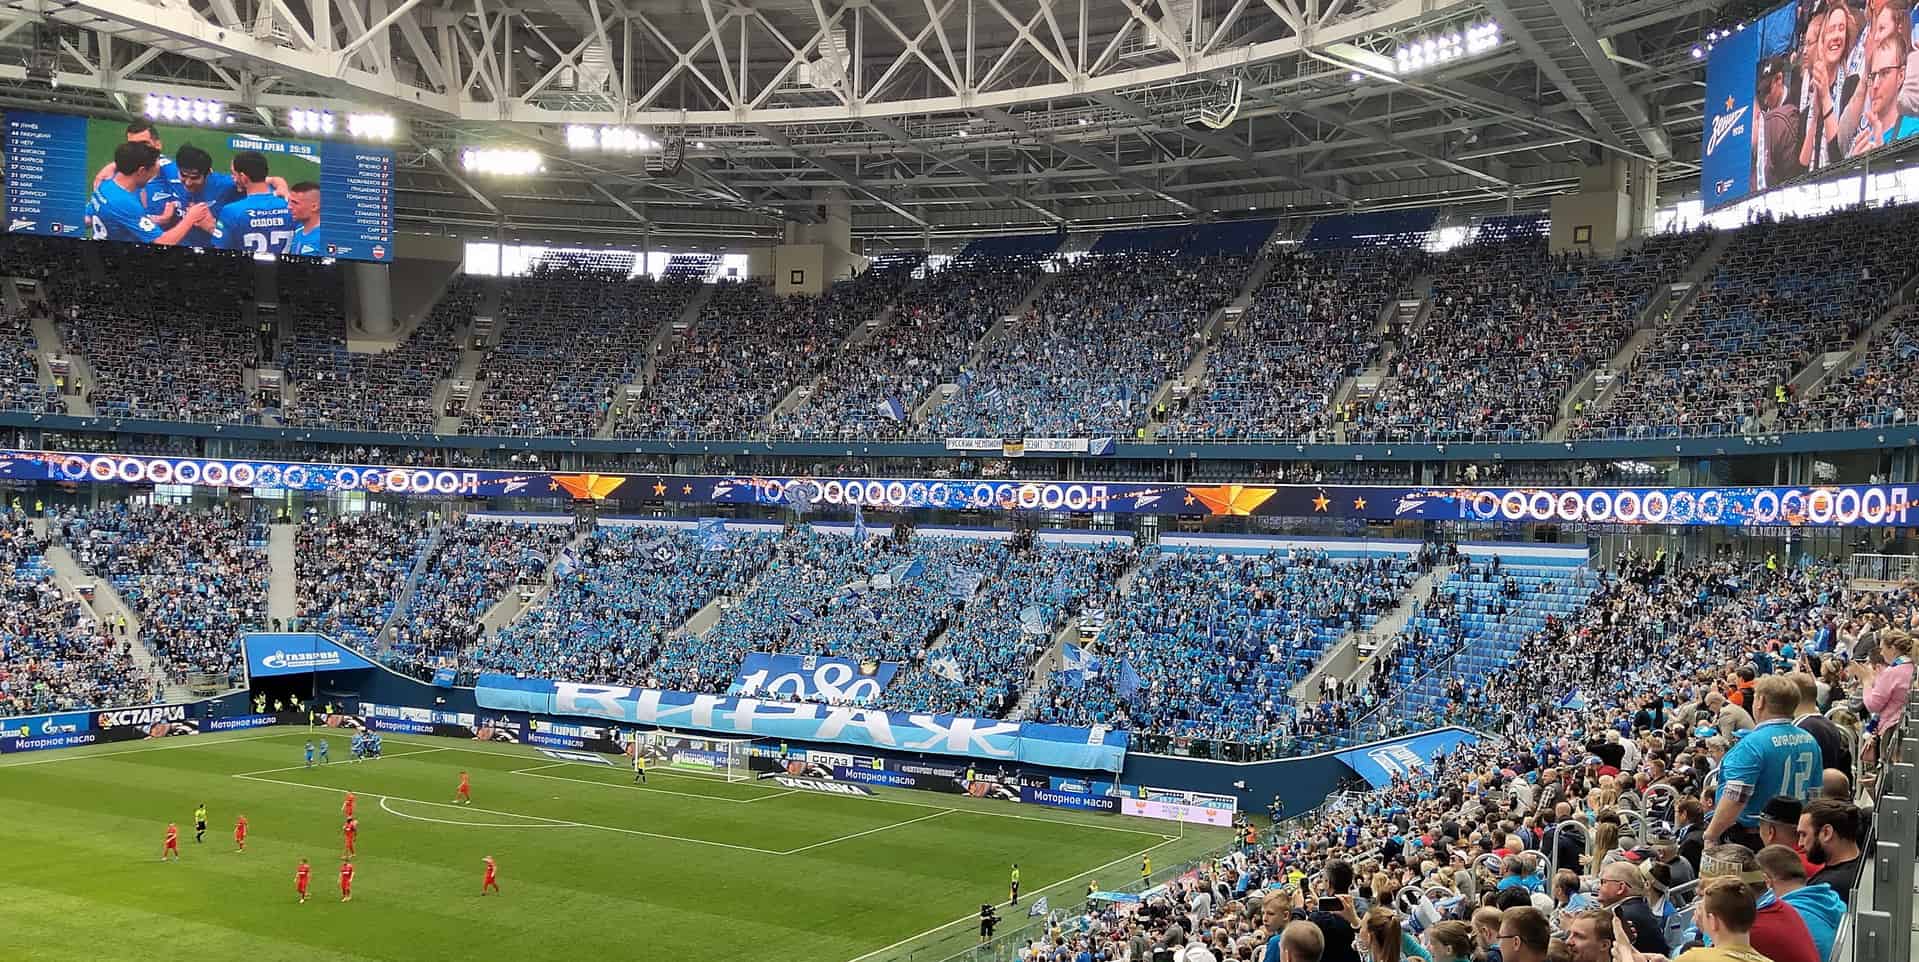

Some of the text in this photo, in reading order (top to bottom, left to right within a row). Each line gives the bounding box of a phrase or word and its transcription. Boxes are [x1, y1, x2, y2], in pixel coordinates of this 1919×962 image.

[210, 717, 277, 729] Моторное масло
[375, 720, 411, 732] Моторное
[553, 681, 1021, 756] ВИРАЖ
[16, 735, 96, 750] Моторное масло
[562, 739, 584, 747] масло
[812, 755, 848, 766] СОГАЗ
[845, 768, 916, 785] Моторное масло
[1779, 752, 1813, 800] 12
[1034, 790, 1113, 809] Моторное масло
